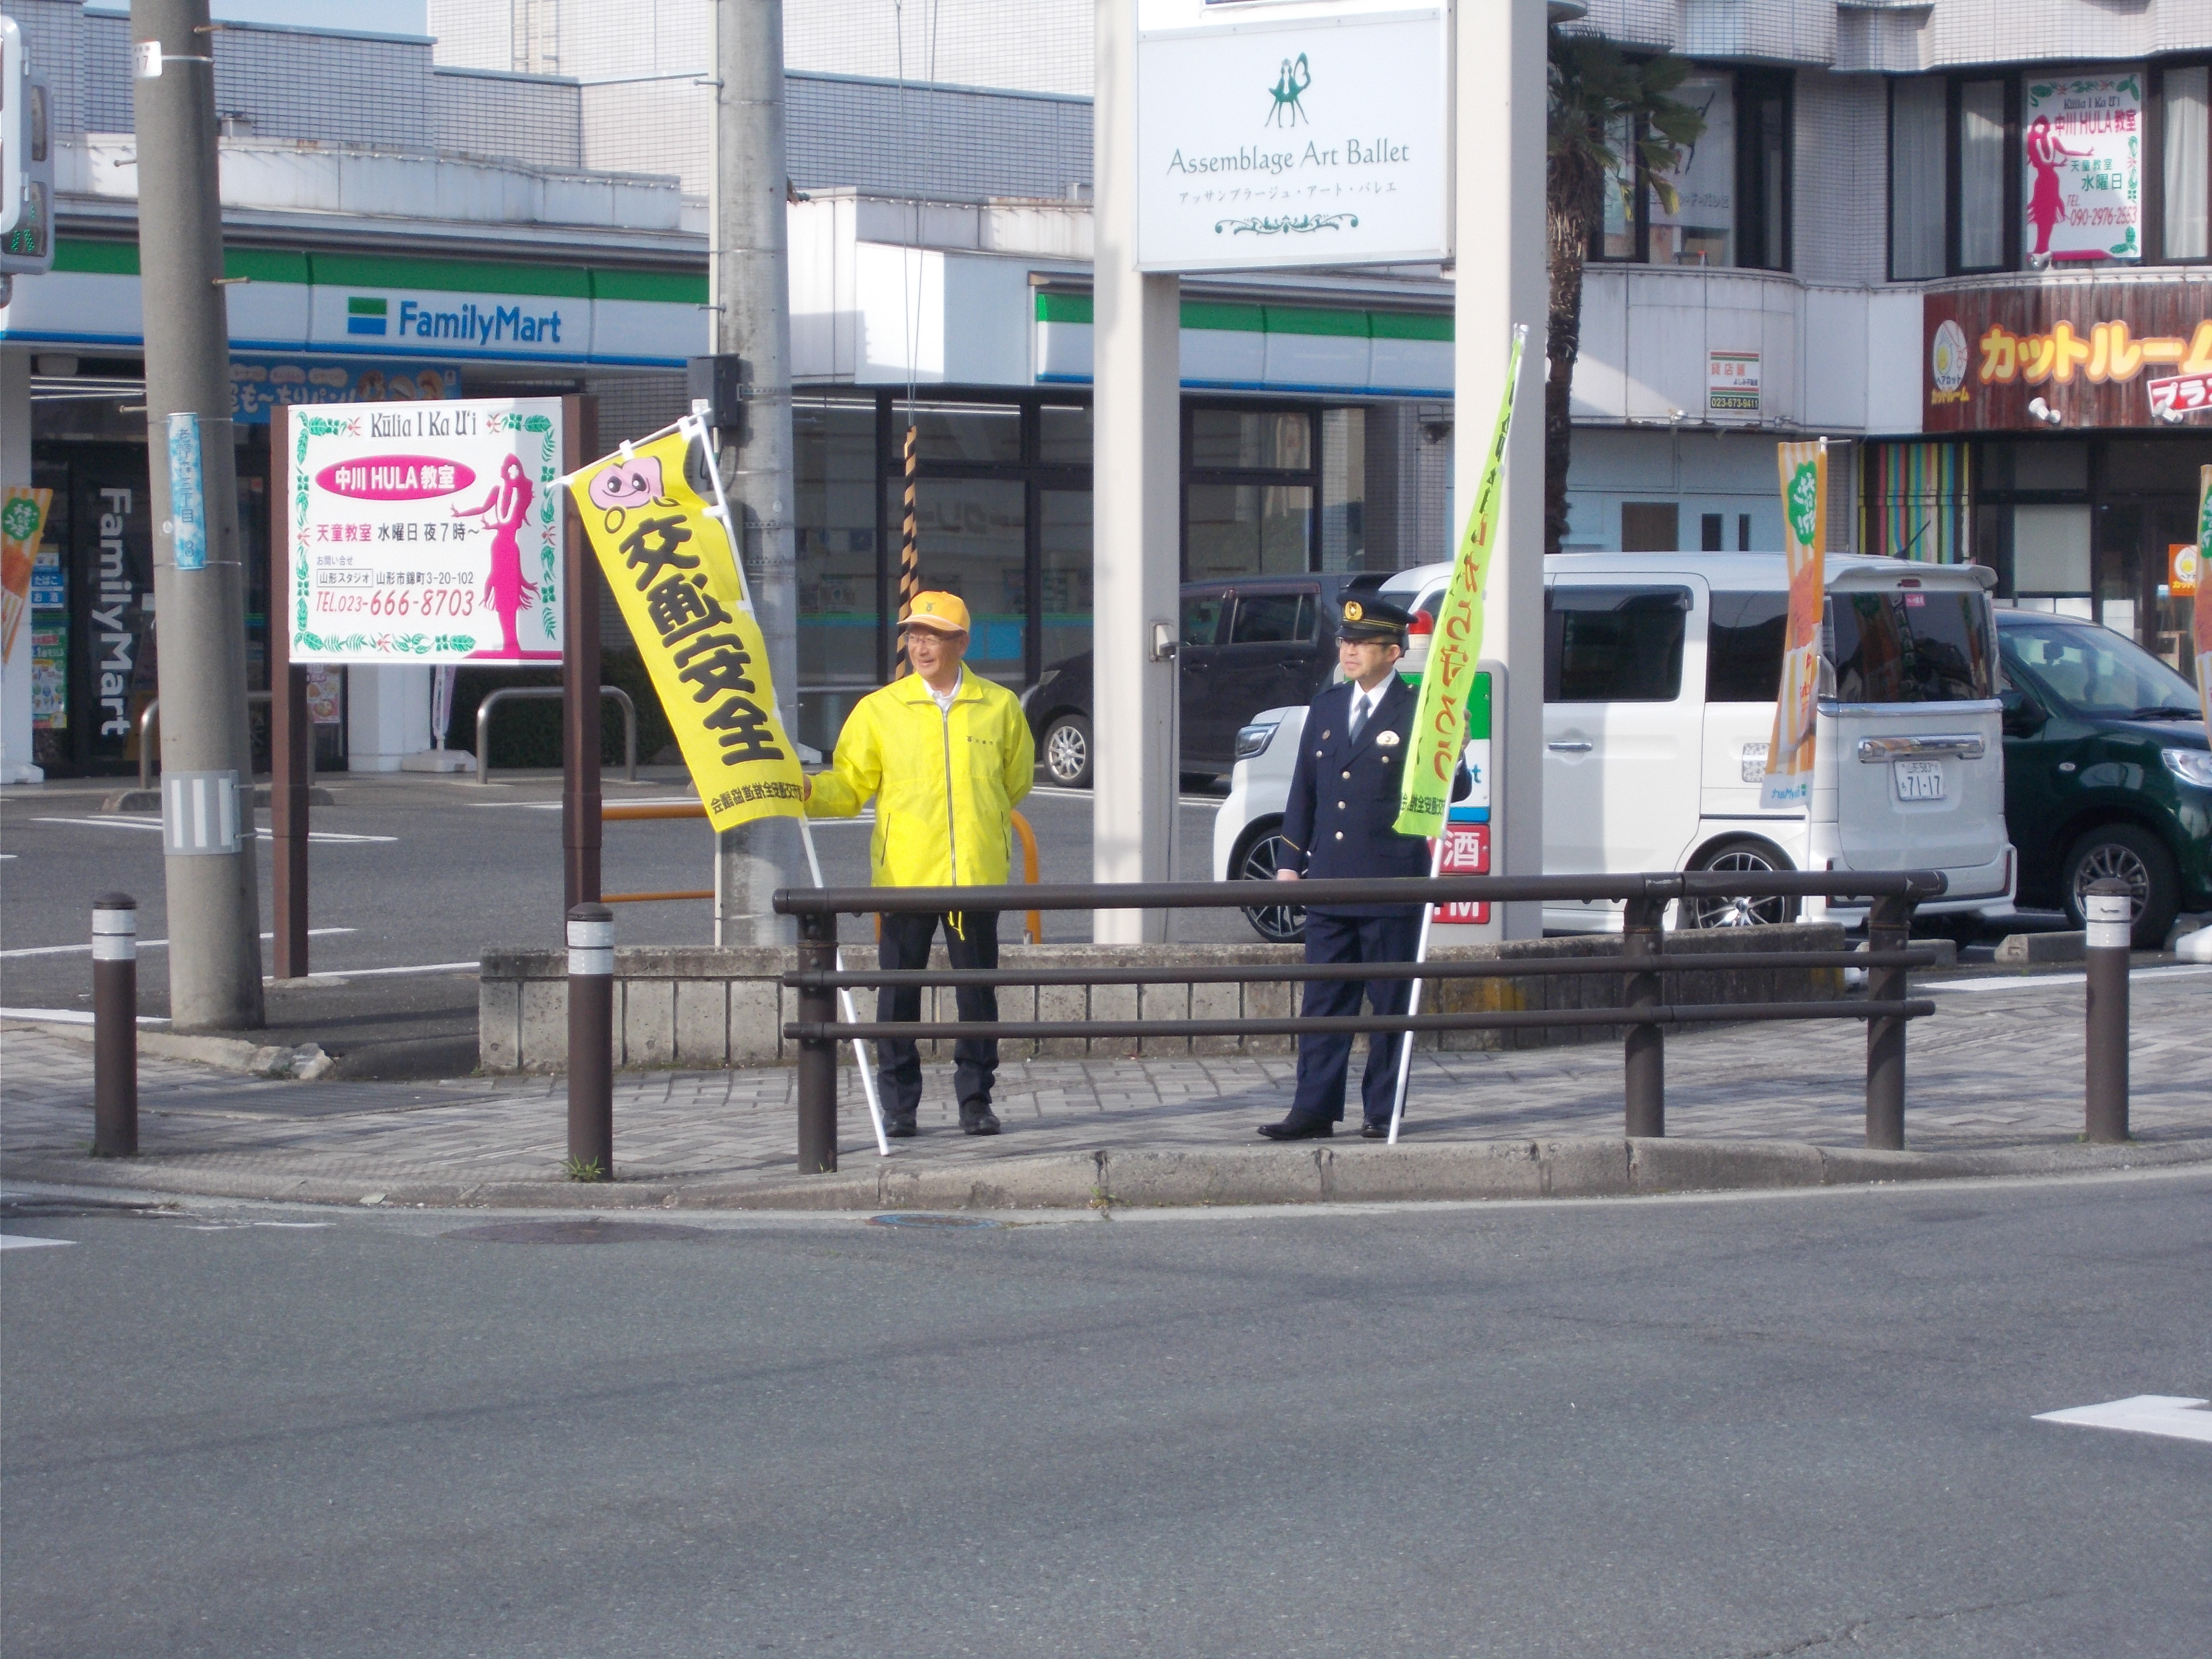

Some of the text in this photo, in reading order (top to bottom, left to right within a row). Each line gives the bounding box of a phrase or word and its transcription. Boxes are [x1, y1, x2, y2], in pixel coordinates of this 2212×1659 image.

[2055, 108, 2136, 136] 中川 HULA 教室
[1167, 138, 1410, 175] Assemblage Art Ballet
[2070, 159, 2112, 172] 天童教室
[2081, 173, 2122, 192] 水曜日
[399, 300, 562, 345] FamilyMart
[417, 411, 424, 437] I
[428, 410, 450, 436] Ka
[336, 464, 455, 491] 中川 HULA 教室
[316, 523, 372, 542] 天童教室
[377, 523, 418, 542] 水曜日
[185, 540, 194, 557] 8
[316, 555, 353, 566] お問い合せ
[319, 571, 474, 585] 山形スタジオ 山形市錦町3-20-102
[91, 488, 133, 736] FamilyMart
[316, 589, 475, 616] TEL.023-666-8703
[1443, 831, 1479, 867] 酒
